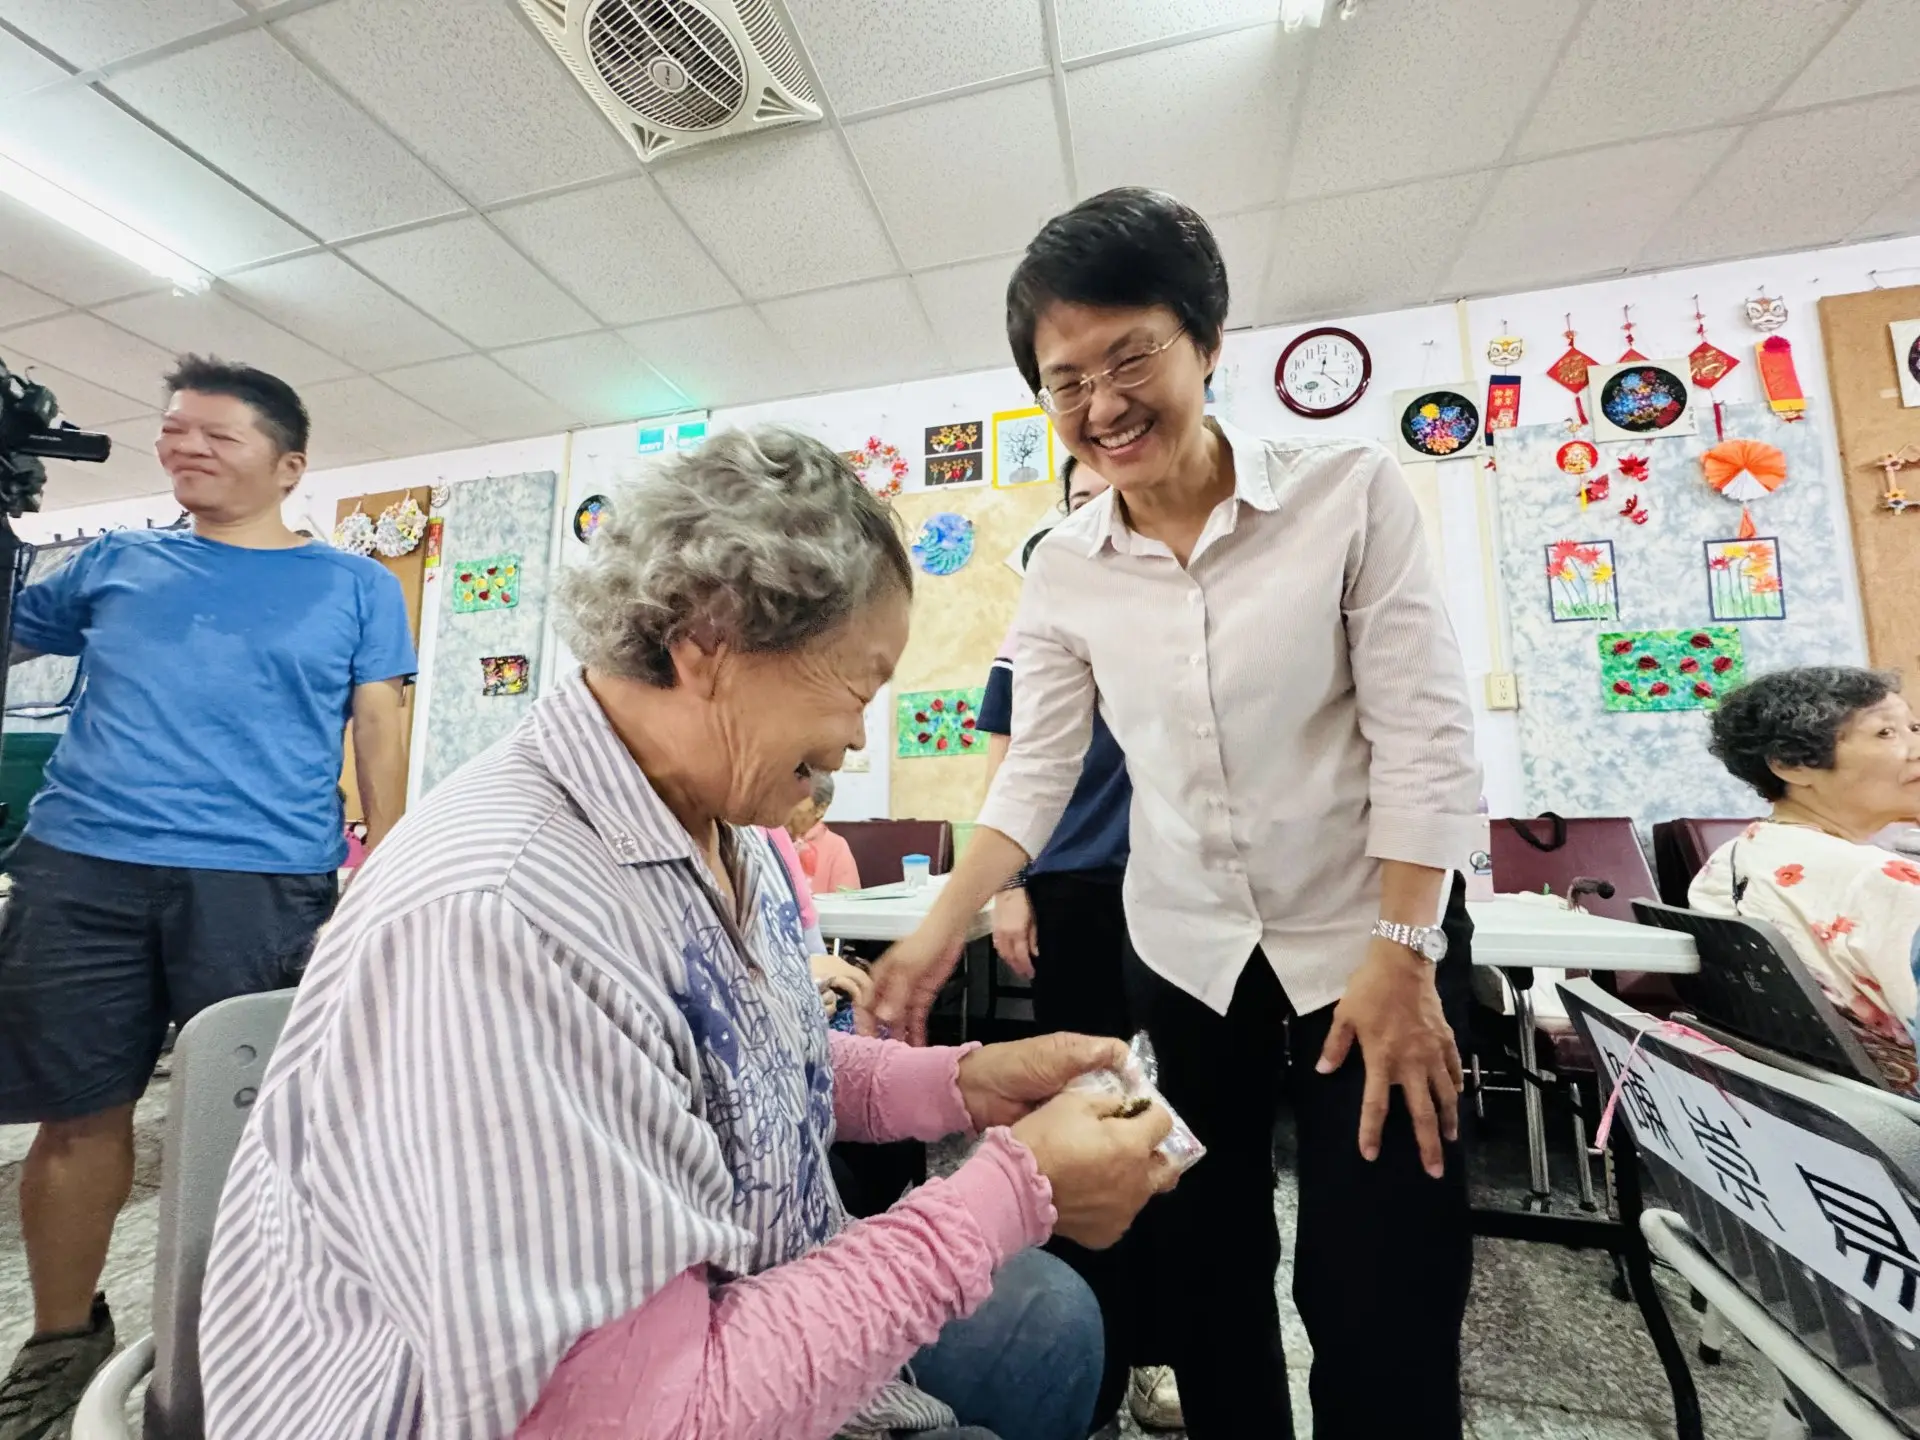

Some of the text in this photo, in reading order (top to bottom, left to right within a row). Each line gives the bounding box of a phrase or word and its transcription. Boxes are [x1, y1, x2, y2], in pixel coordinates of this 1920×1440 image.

[1306, 348, 1314, 360] 11
[1317, 344, 1327, 355] 12
[1342, 352, 1350, 363] 2
[1294, 359, 1305, 371] 10
